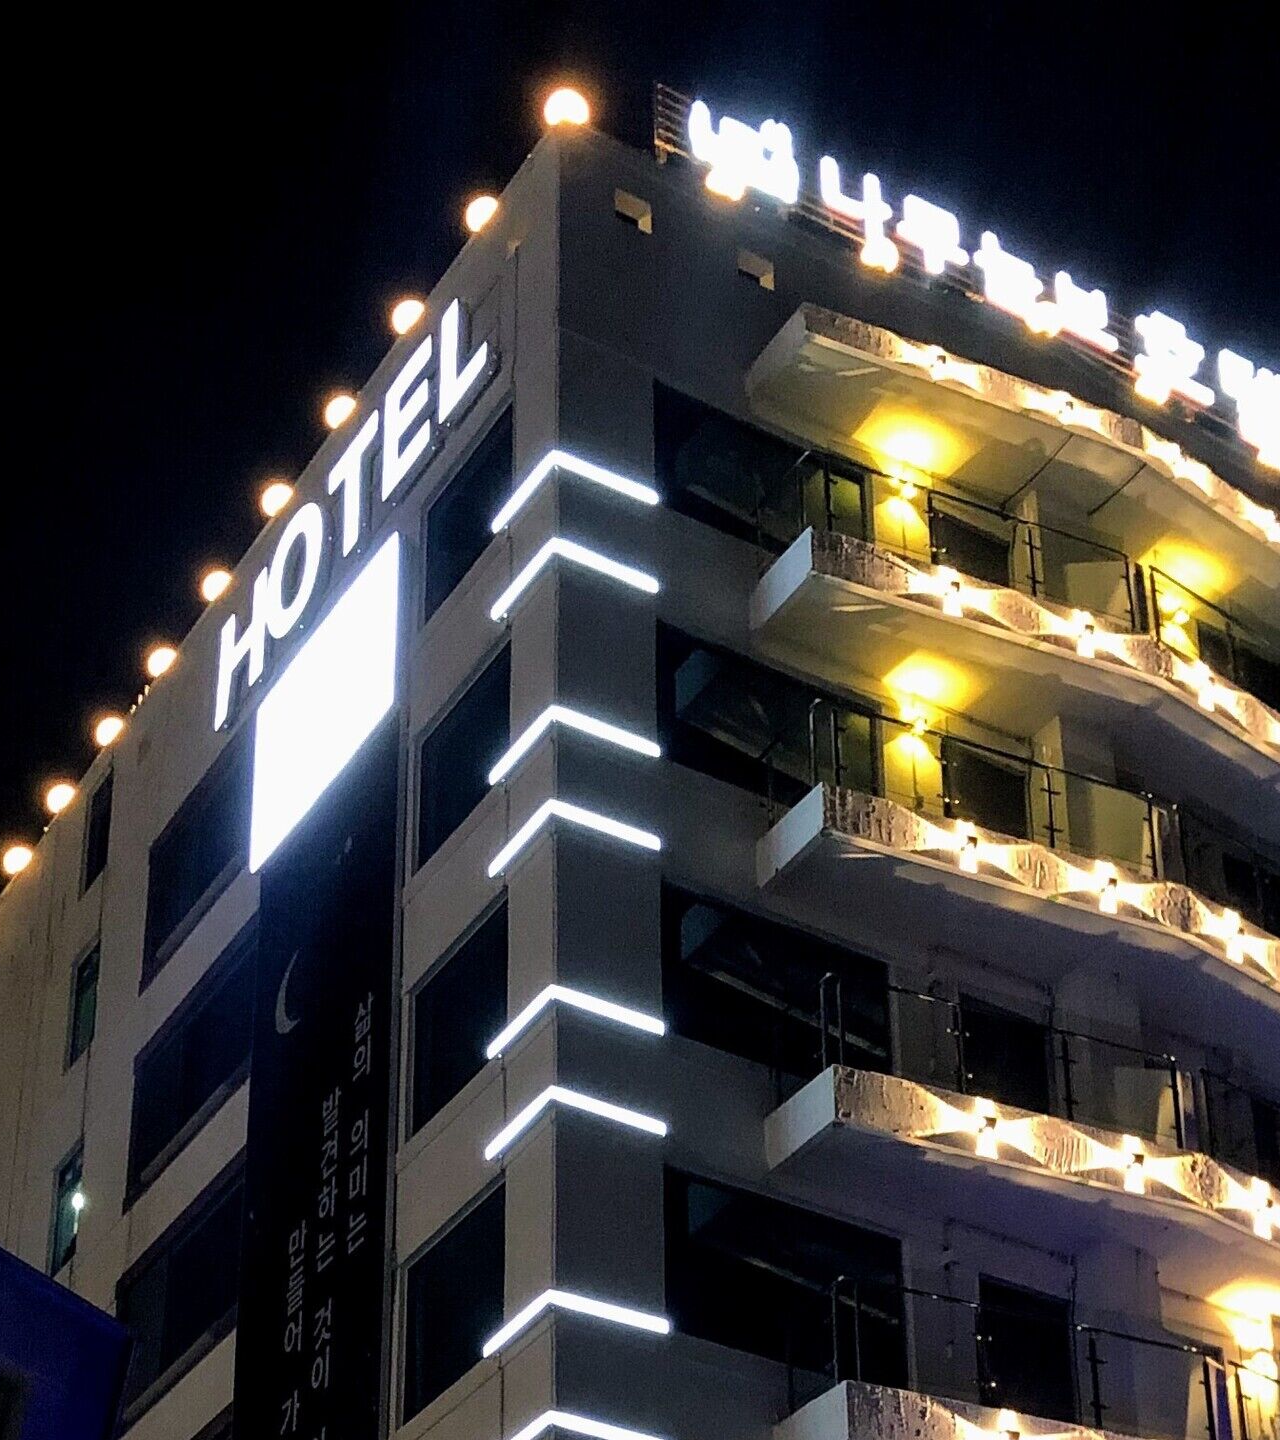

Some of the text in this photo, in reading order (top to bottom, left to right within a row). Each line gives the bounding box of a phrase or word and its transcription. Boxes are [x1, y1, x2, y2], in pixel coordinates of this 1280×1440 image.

[214, 298, 488, 733] HOTEL
[315, 1085, 342, 1273] 발견하는
[347, 1107, 371, 1256] 의미는
[284, 1218, 309, 1352] 만들어
[310, 1296, 335, 1390] 것이
